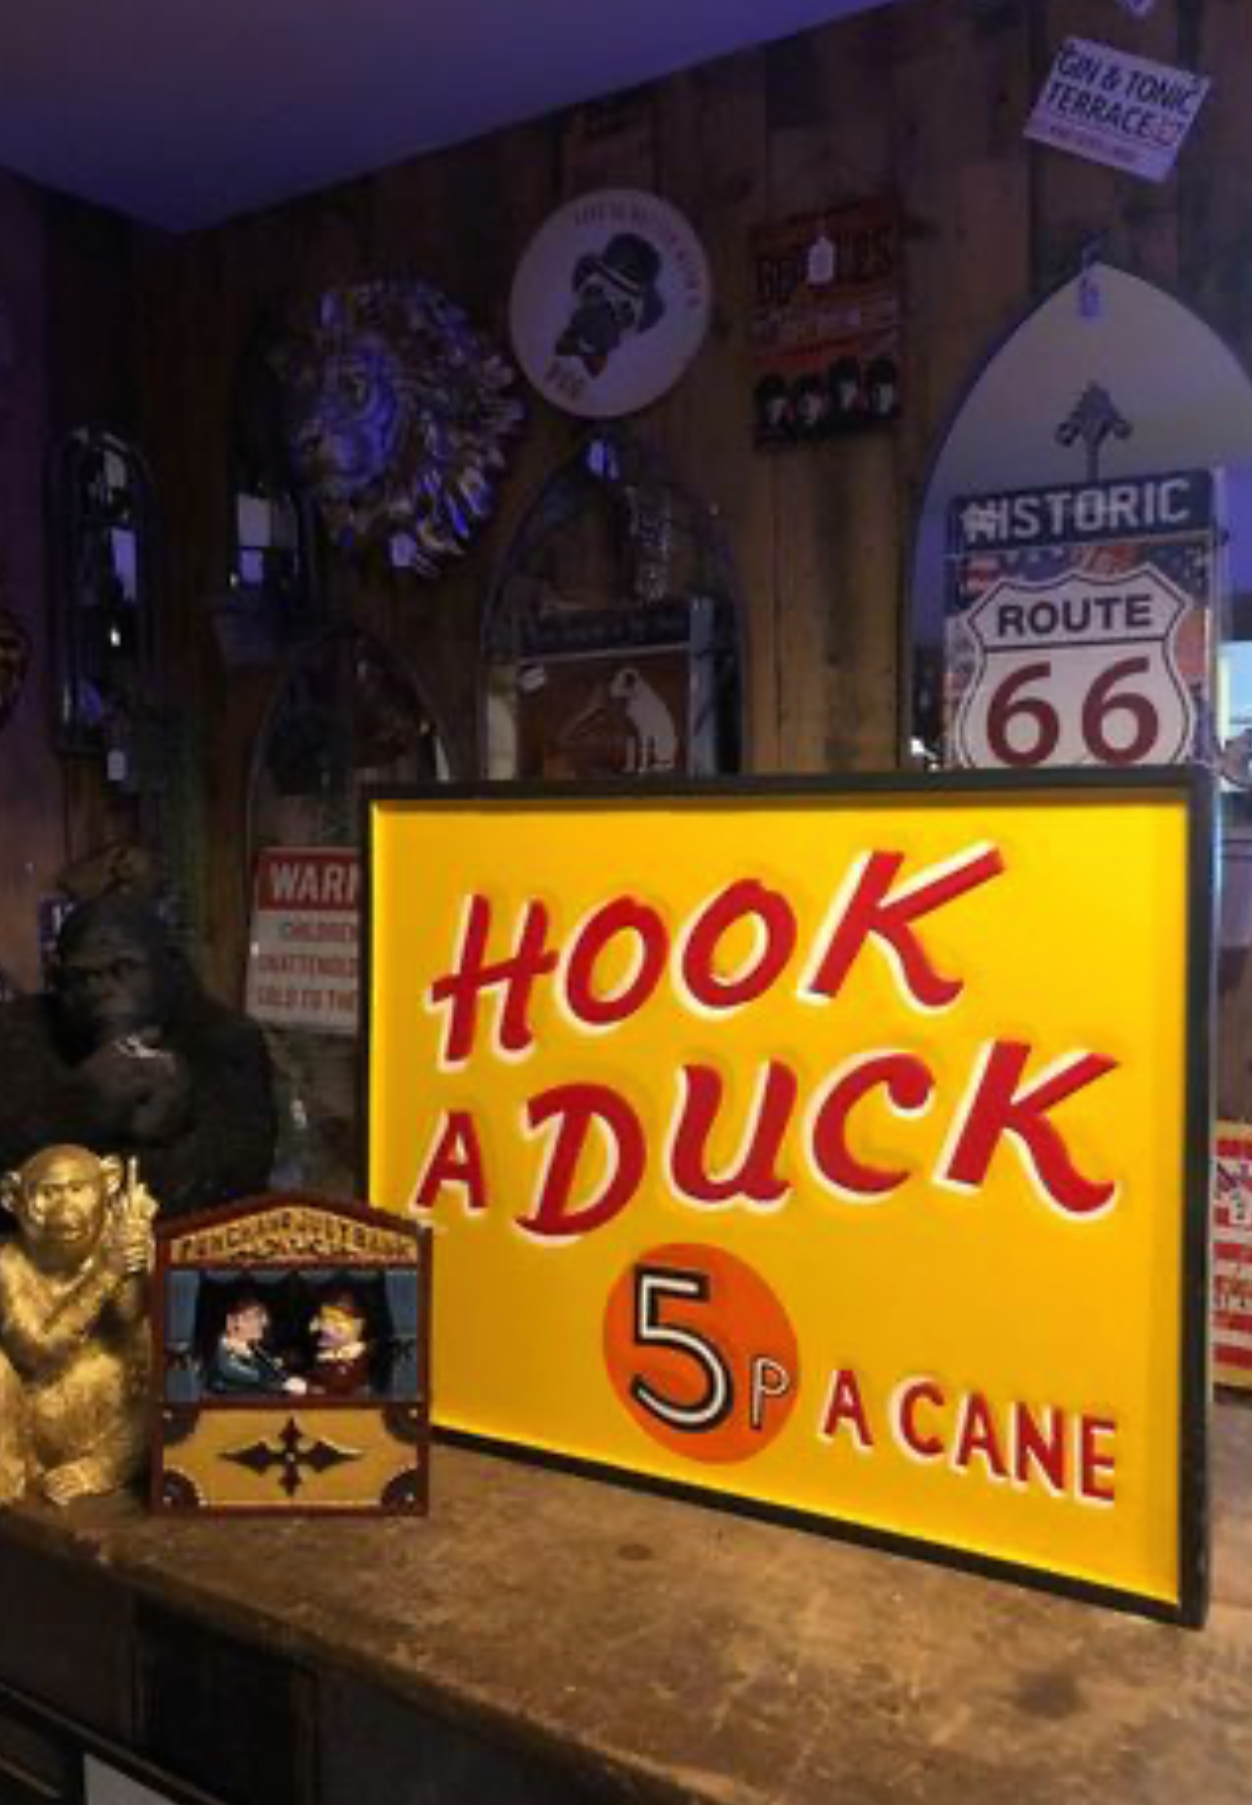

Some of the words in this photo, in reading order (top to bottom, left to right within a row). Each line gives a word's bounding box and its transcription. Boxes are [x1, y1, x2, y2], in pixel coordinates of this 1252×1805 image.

[1048, 82, 1155, 138] TERRACE
[1057, 52, 1100, 85] GIN
[1101, 66, 1122, 91] &
[1126, 70, 1199, 116] TONIC
[960, 477, 1190, 542] HISTORIC
[998, 593, 1153, 637] ROUTE
[987, 656, 1159, 767] 66
[425, 839, 1005, 1072] HOOK
[409, 1109, 488, 1216] A
[511, 1037, 1121, 1246] DUCK
[818, 1367, 875, 1456] A
[892, 1374, 1116, 1509] CANE
